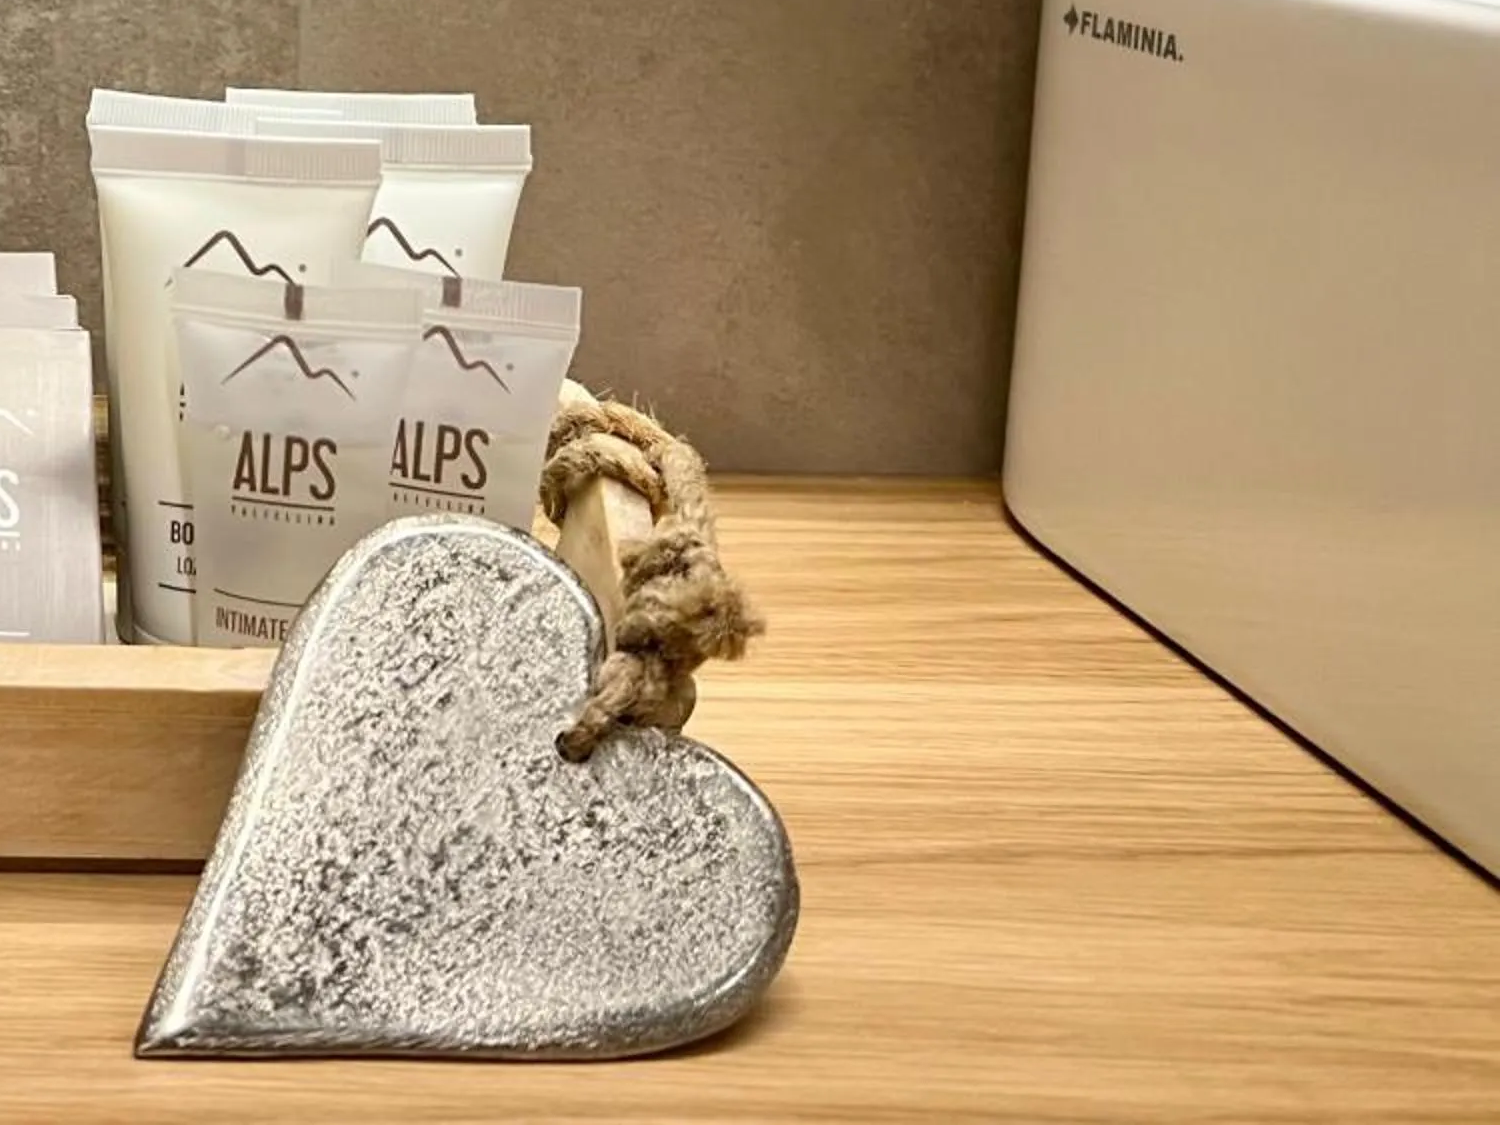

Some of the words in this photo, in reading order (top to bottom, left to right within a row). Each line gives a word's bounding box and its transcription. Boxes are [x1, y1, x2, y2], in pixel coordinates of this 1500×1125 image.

[233, 430, 337, 501] ALPS
[390, 418, 490, 490] ALPS
[171, 520, 195, 546] BO
[216, 607, 289, 642] INTIMATE
